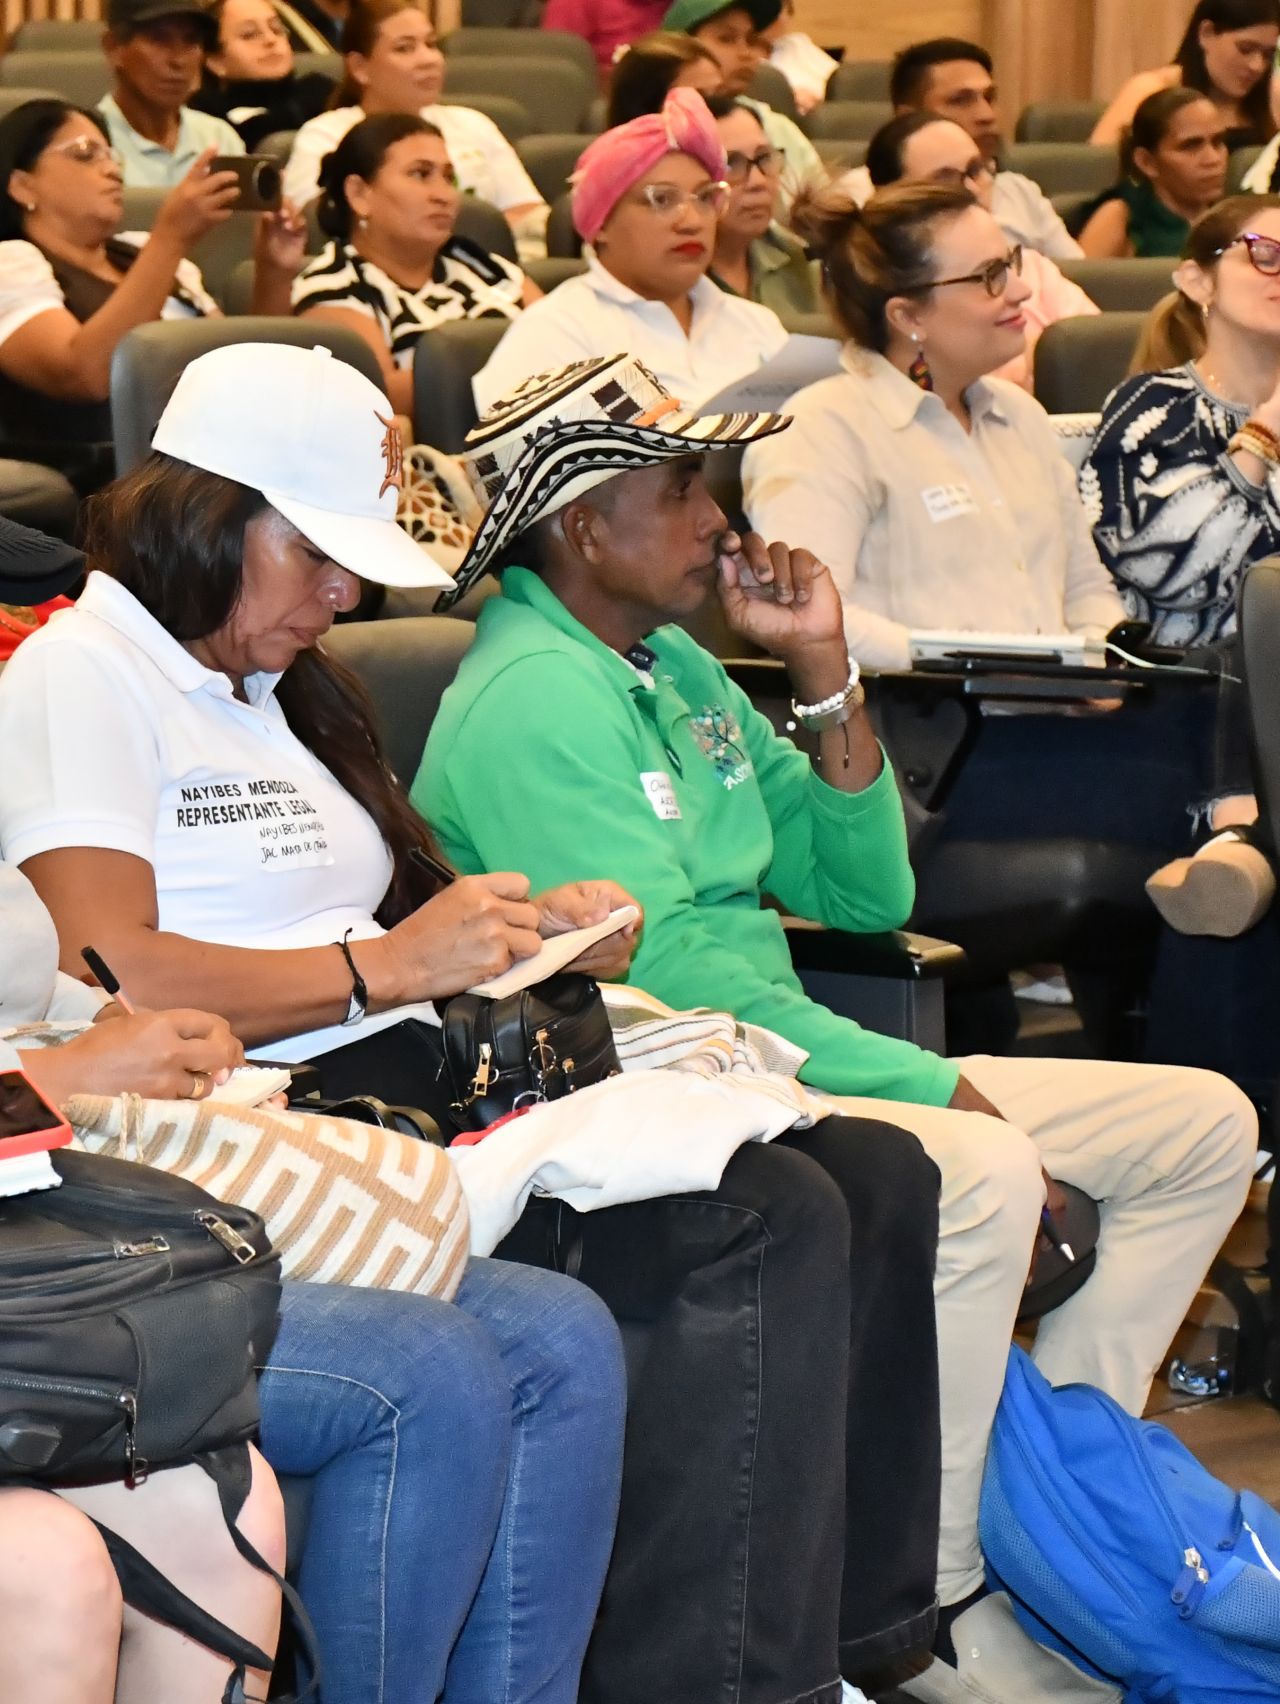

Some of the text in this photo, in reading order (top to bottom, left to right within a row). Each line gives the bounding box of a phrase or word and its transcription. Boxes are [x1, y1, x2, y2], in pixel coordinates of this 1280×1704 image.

[181, 780, 299, 802] NAYIBES MENDOZA
[177, 799, 317, 827] REPRESENTANTE LEGAL
